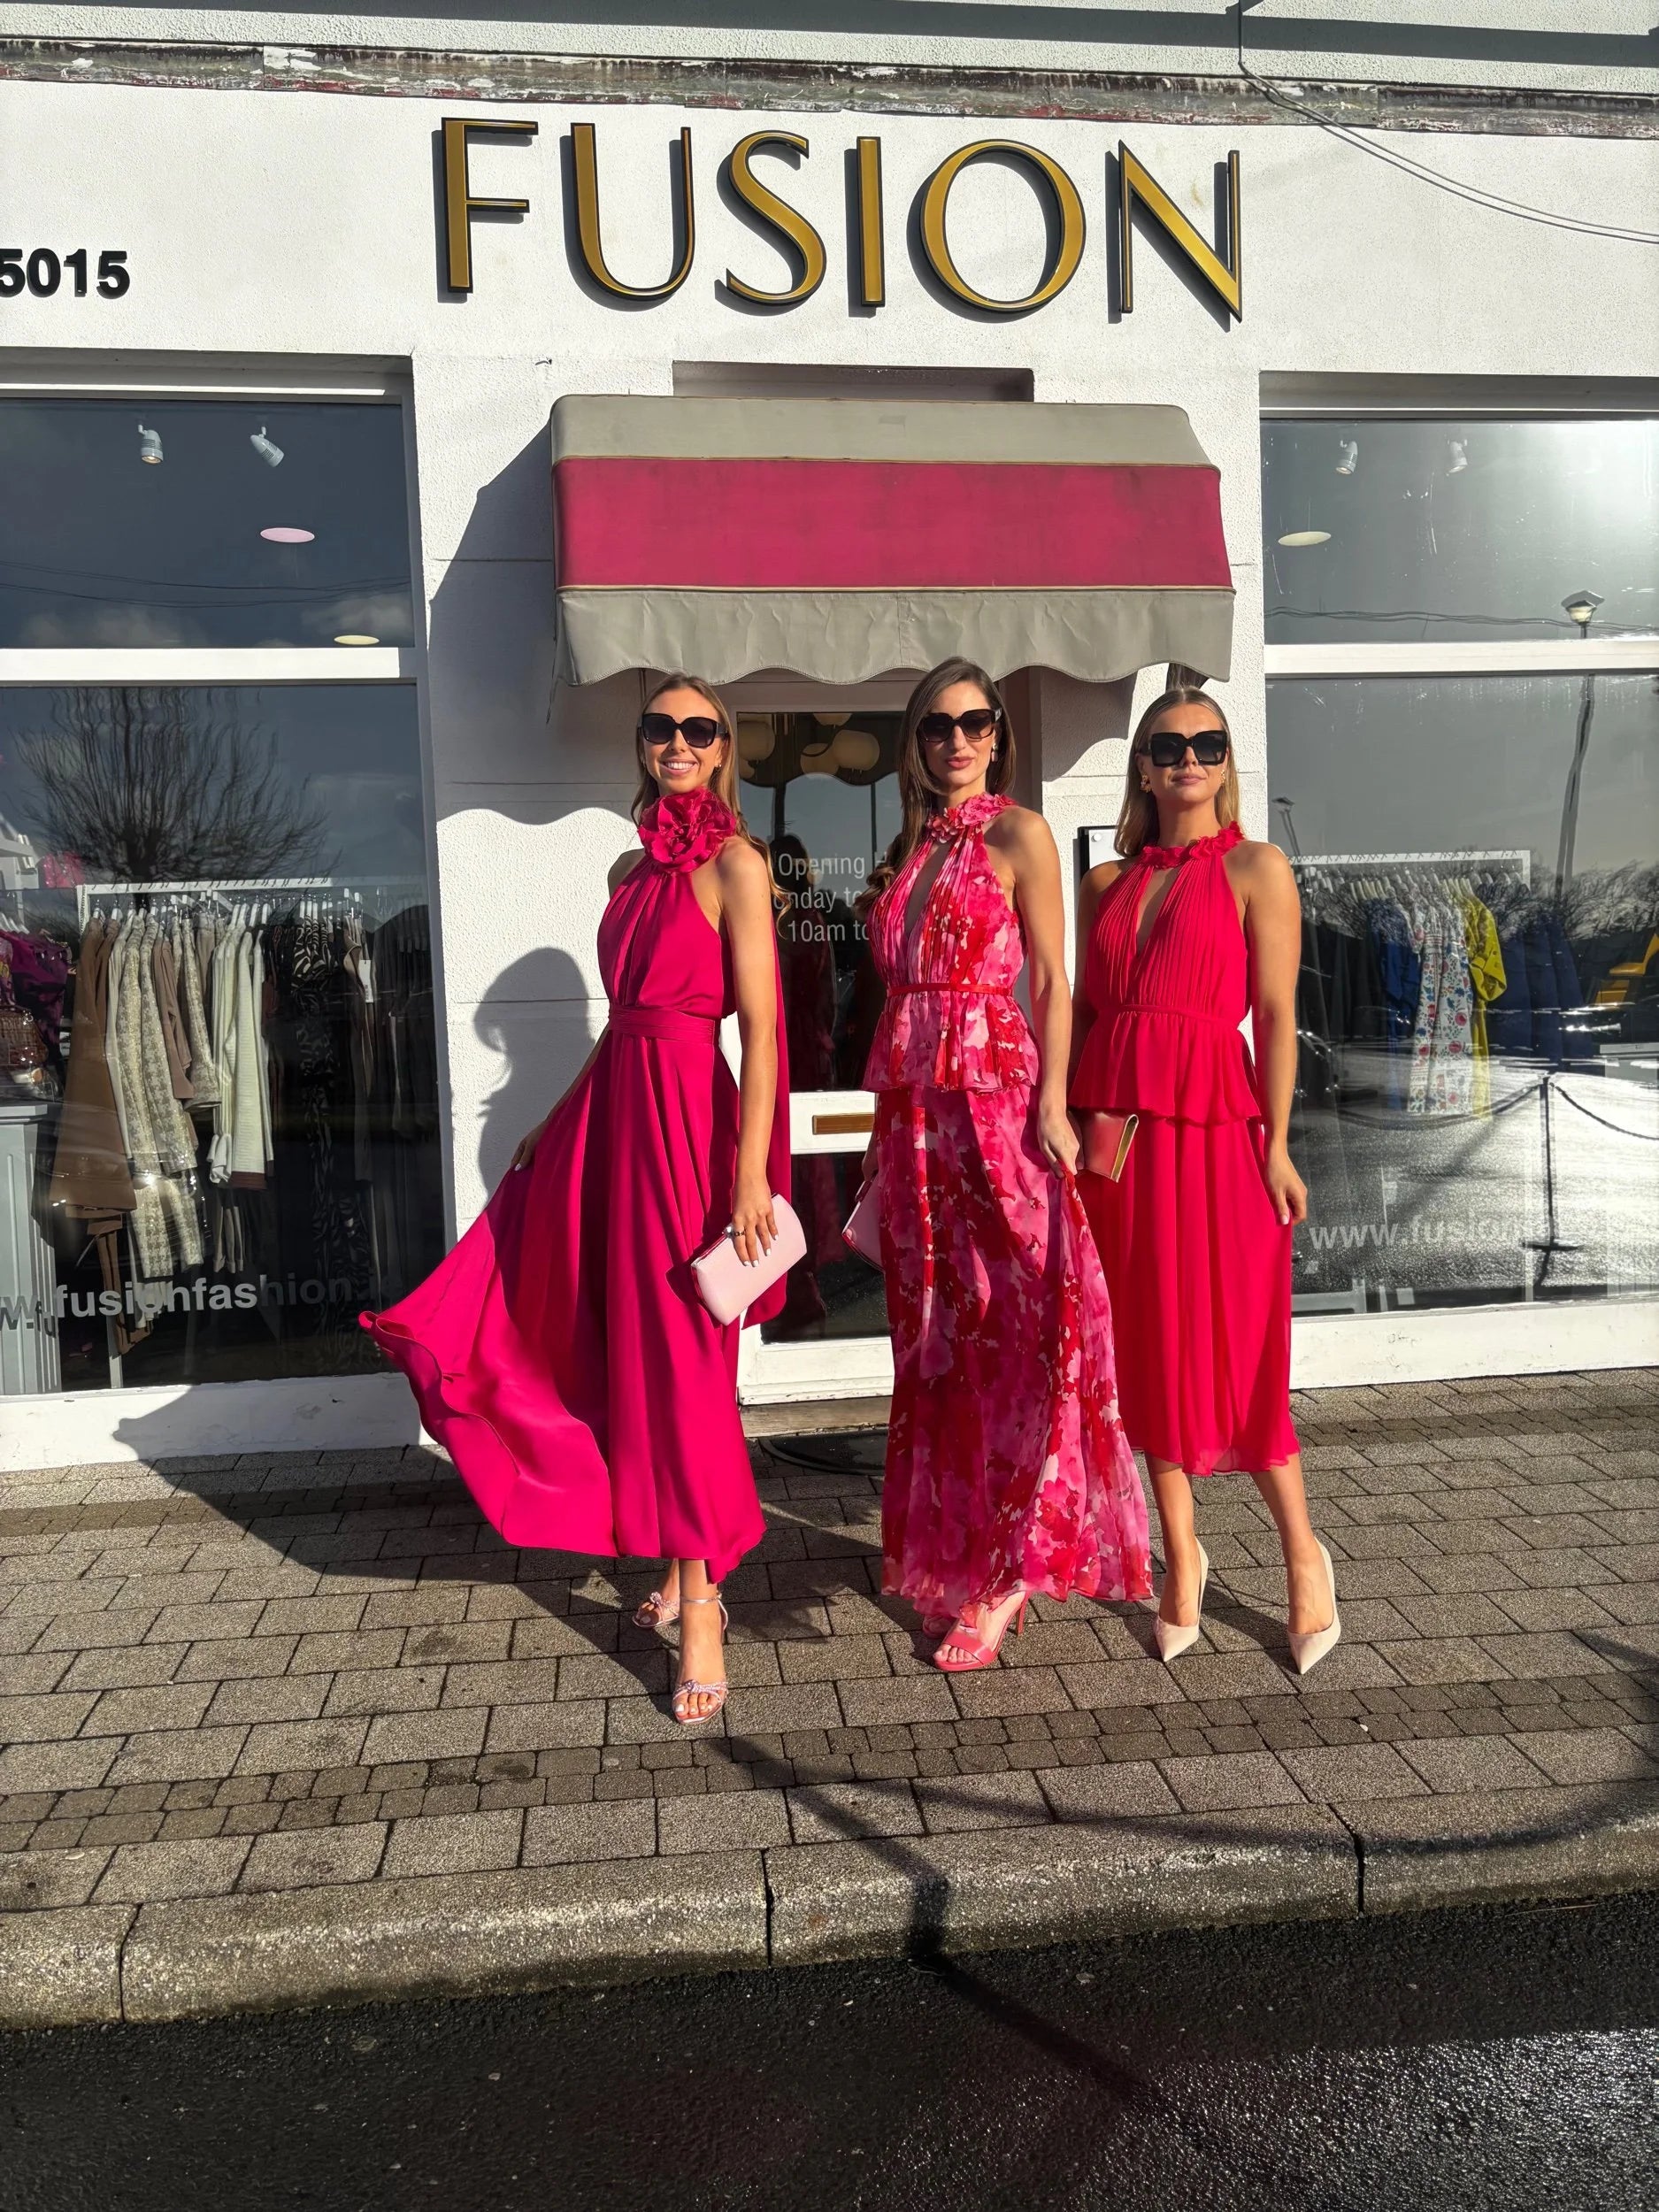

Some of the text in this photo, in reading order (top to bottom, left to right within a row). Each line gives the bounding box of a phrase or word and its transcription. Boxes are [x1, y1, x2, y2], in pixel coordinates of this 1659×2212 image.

[439, 116, 1242, 323] FUSION
[0, 248, 130, 299] 5015
[778, 852, 865, 879] Opening
[773, 887, 836, 912] onday
[787, 919, 846, 942] 10am
